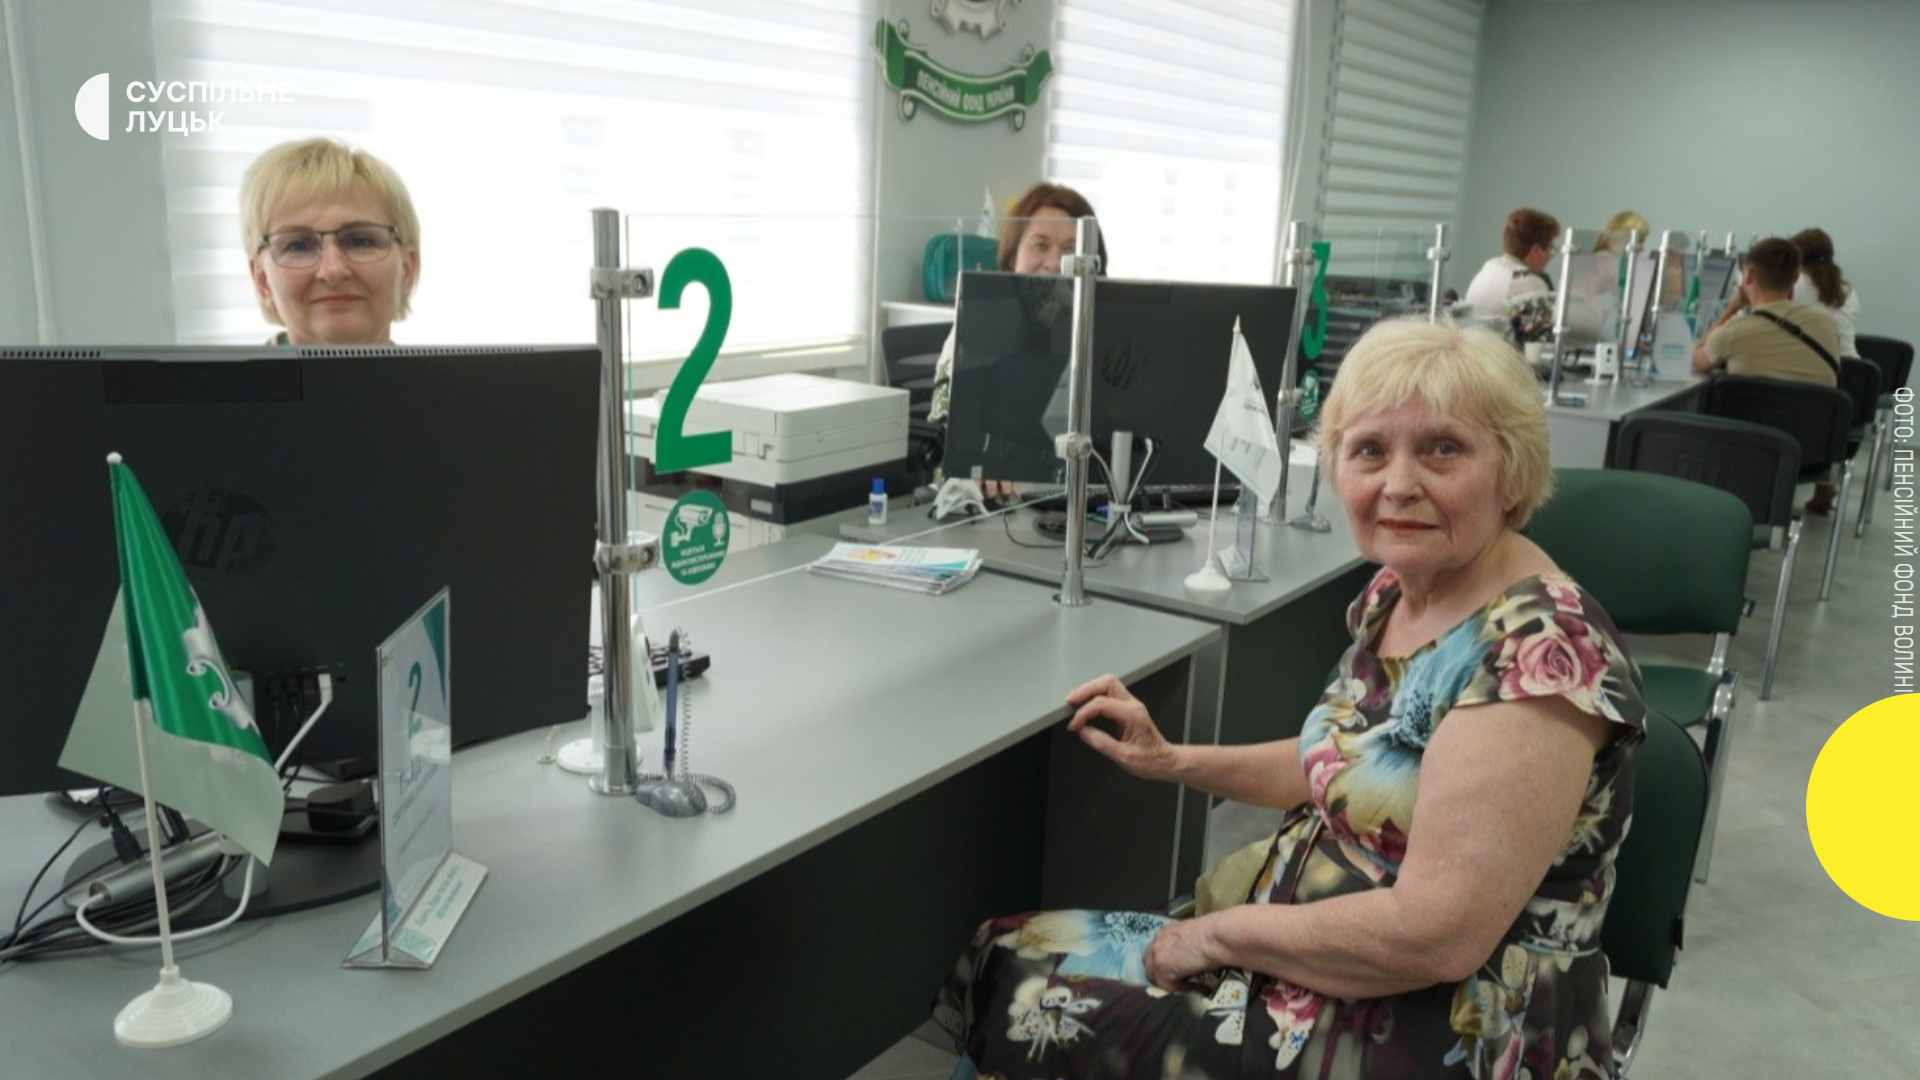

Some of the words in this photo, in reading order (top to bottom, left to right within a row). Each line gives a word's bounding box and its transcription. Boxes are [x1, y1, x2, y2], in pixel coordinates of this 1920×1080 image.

[1303, 242, 1331, 360] 3
[656, 247, 733, 475] 2
[177, 489, 266, 577] hp
